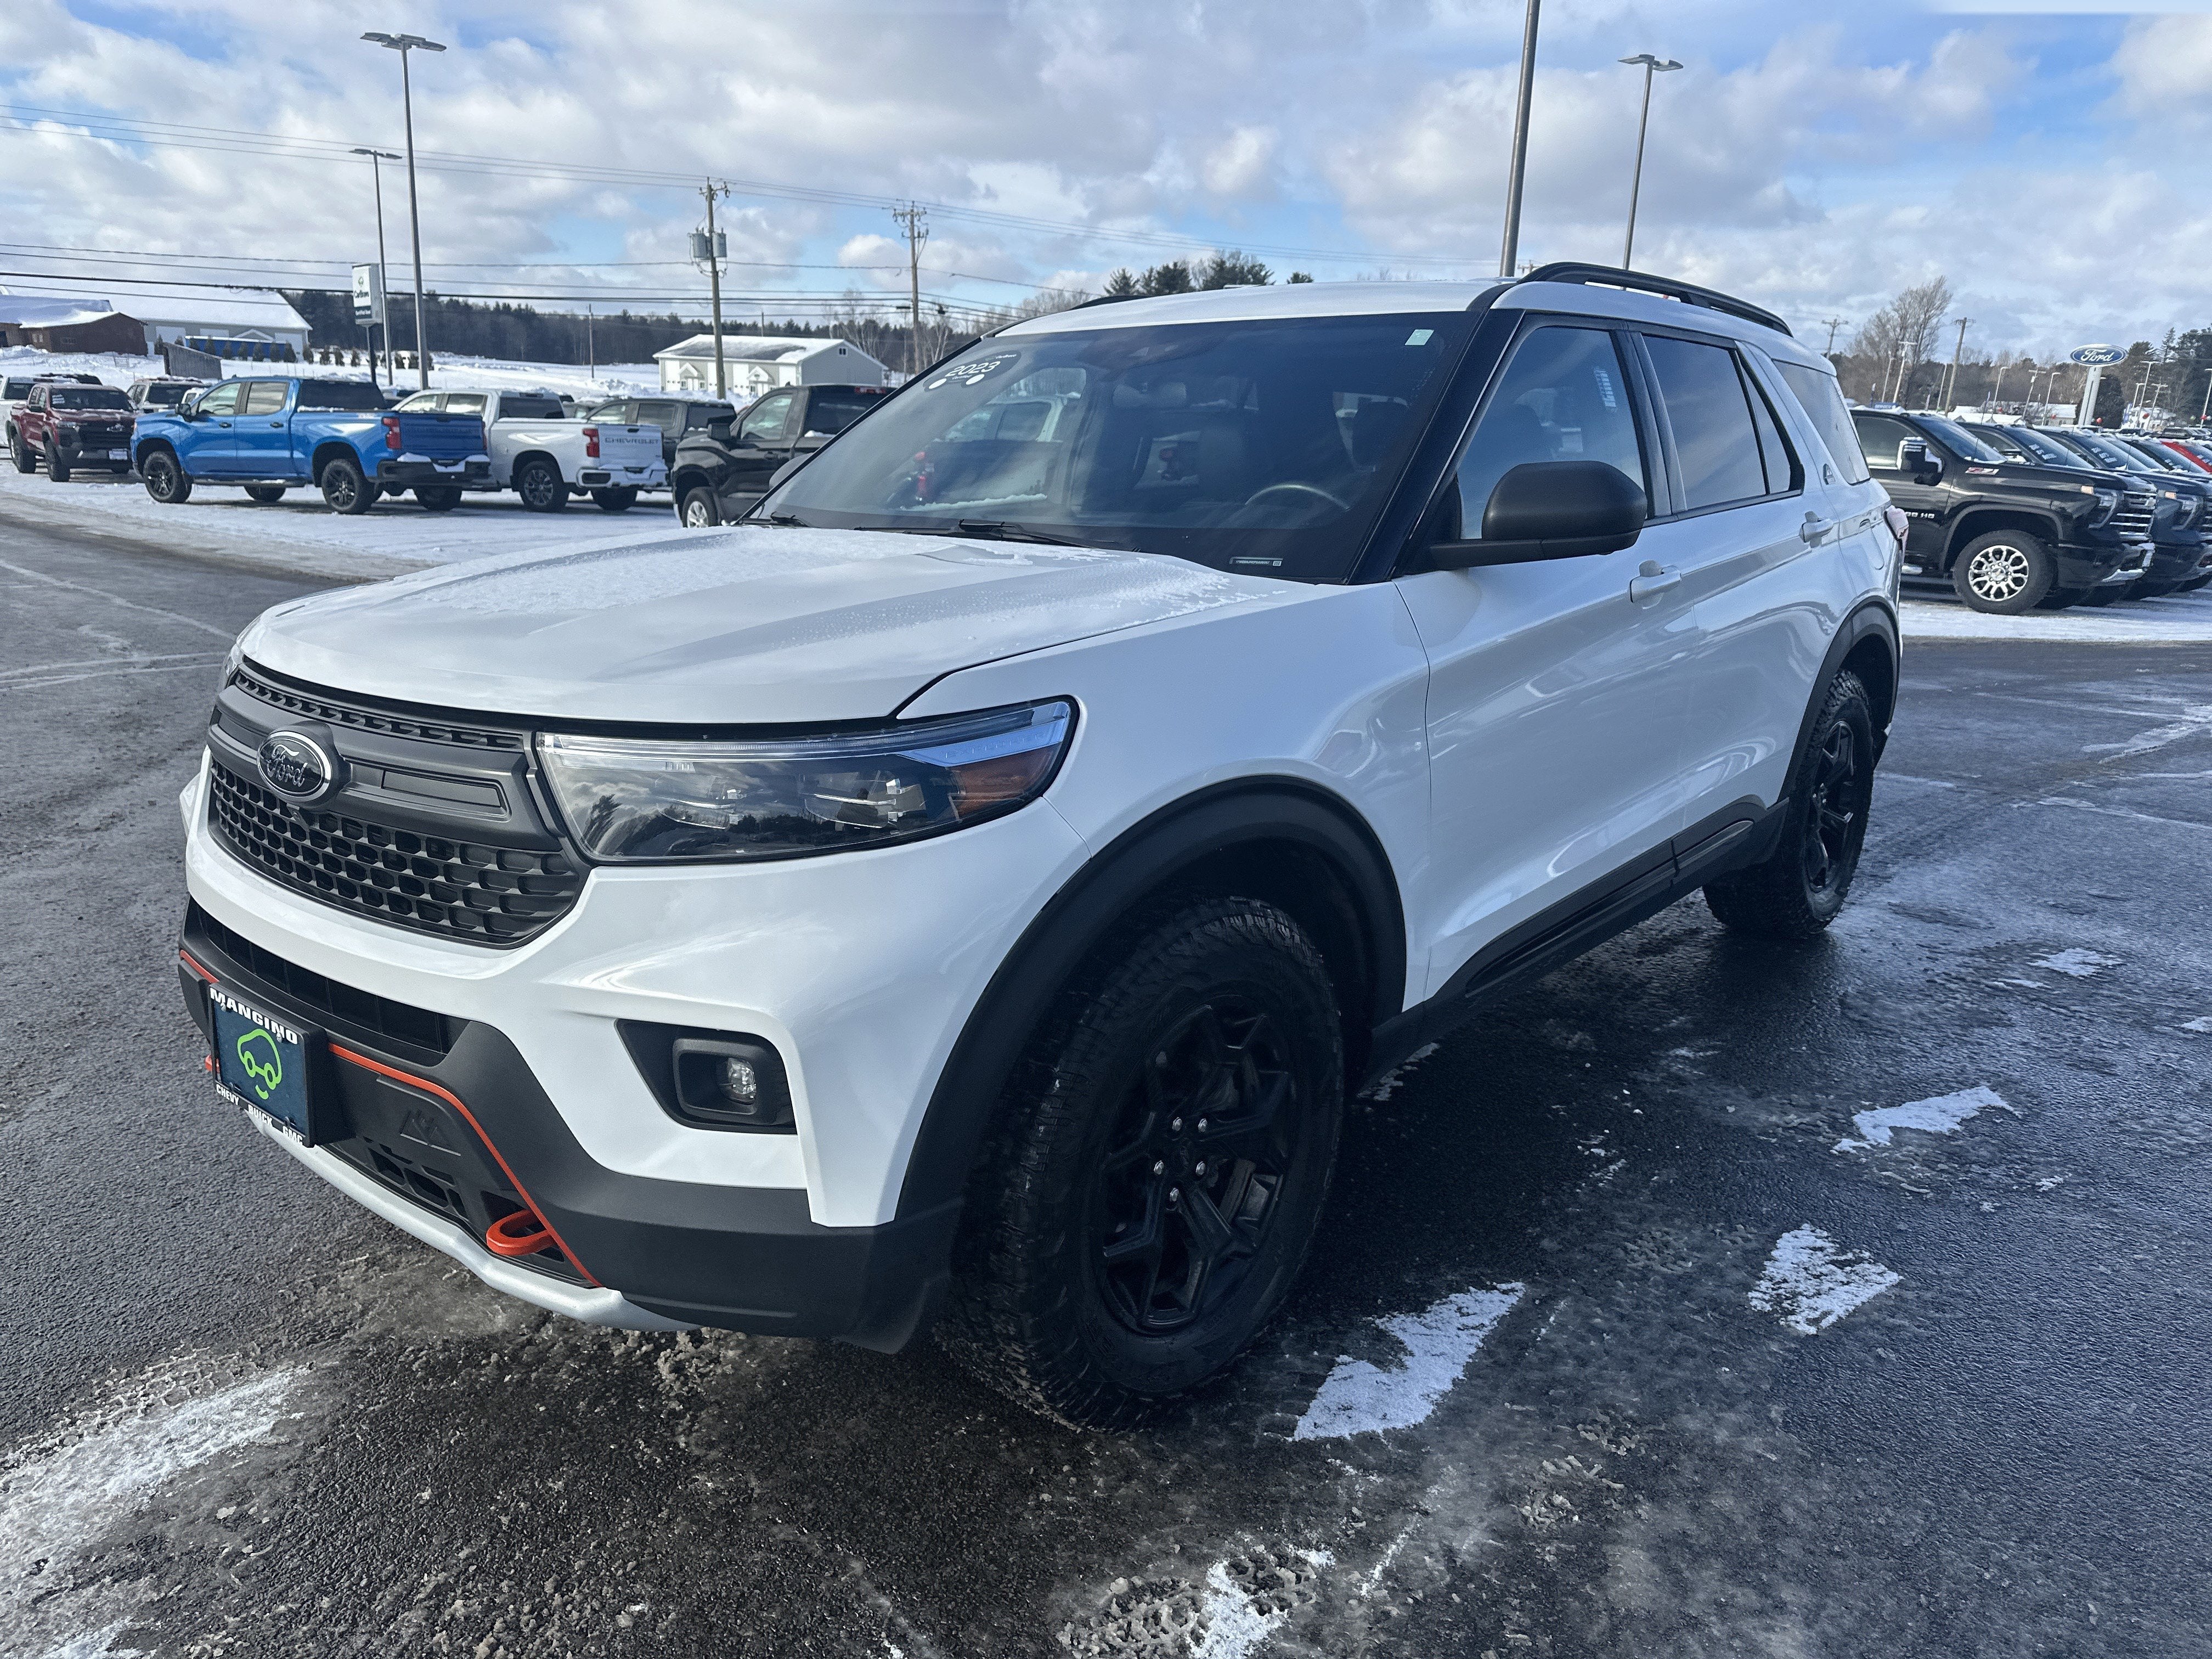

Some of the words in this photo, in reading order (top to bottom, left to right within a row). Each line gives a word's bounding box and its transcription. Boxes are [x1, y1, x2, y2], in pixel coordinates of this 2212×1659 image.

[944, 361, 1001, 377] 2023
[2081, 348, 2114, 362] Ford
[265, 744, 308, 787] Ford
[210, 987, 298, 1045] MANGINO
[216, 1084, 239, 1106] CHEVY
[247, 1104, 274, 1127] BUICK
[282, 1125, 303, 1144] GMC
